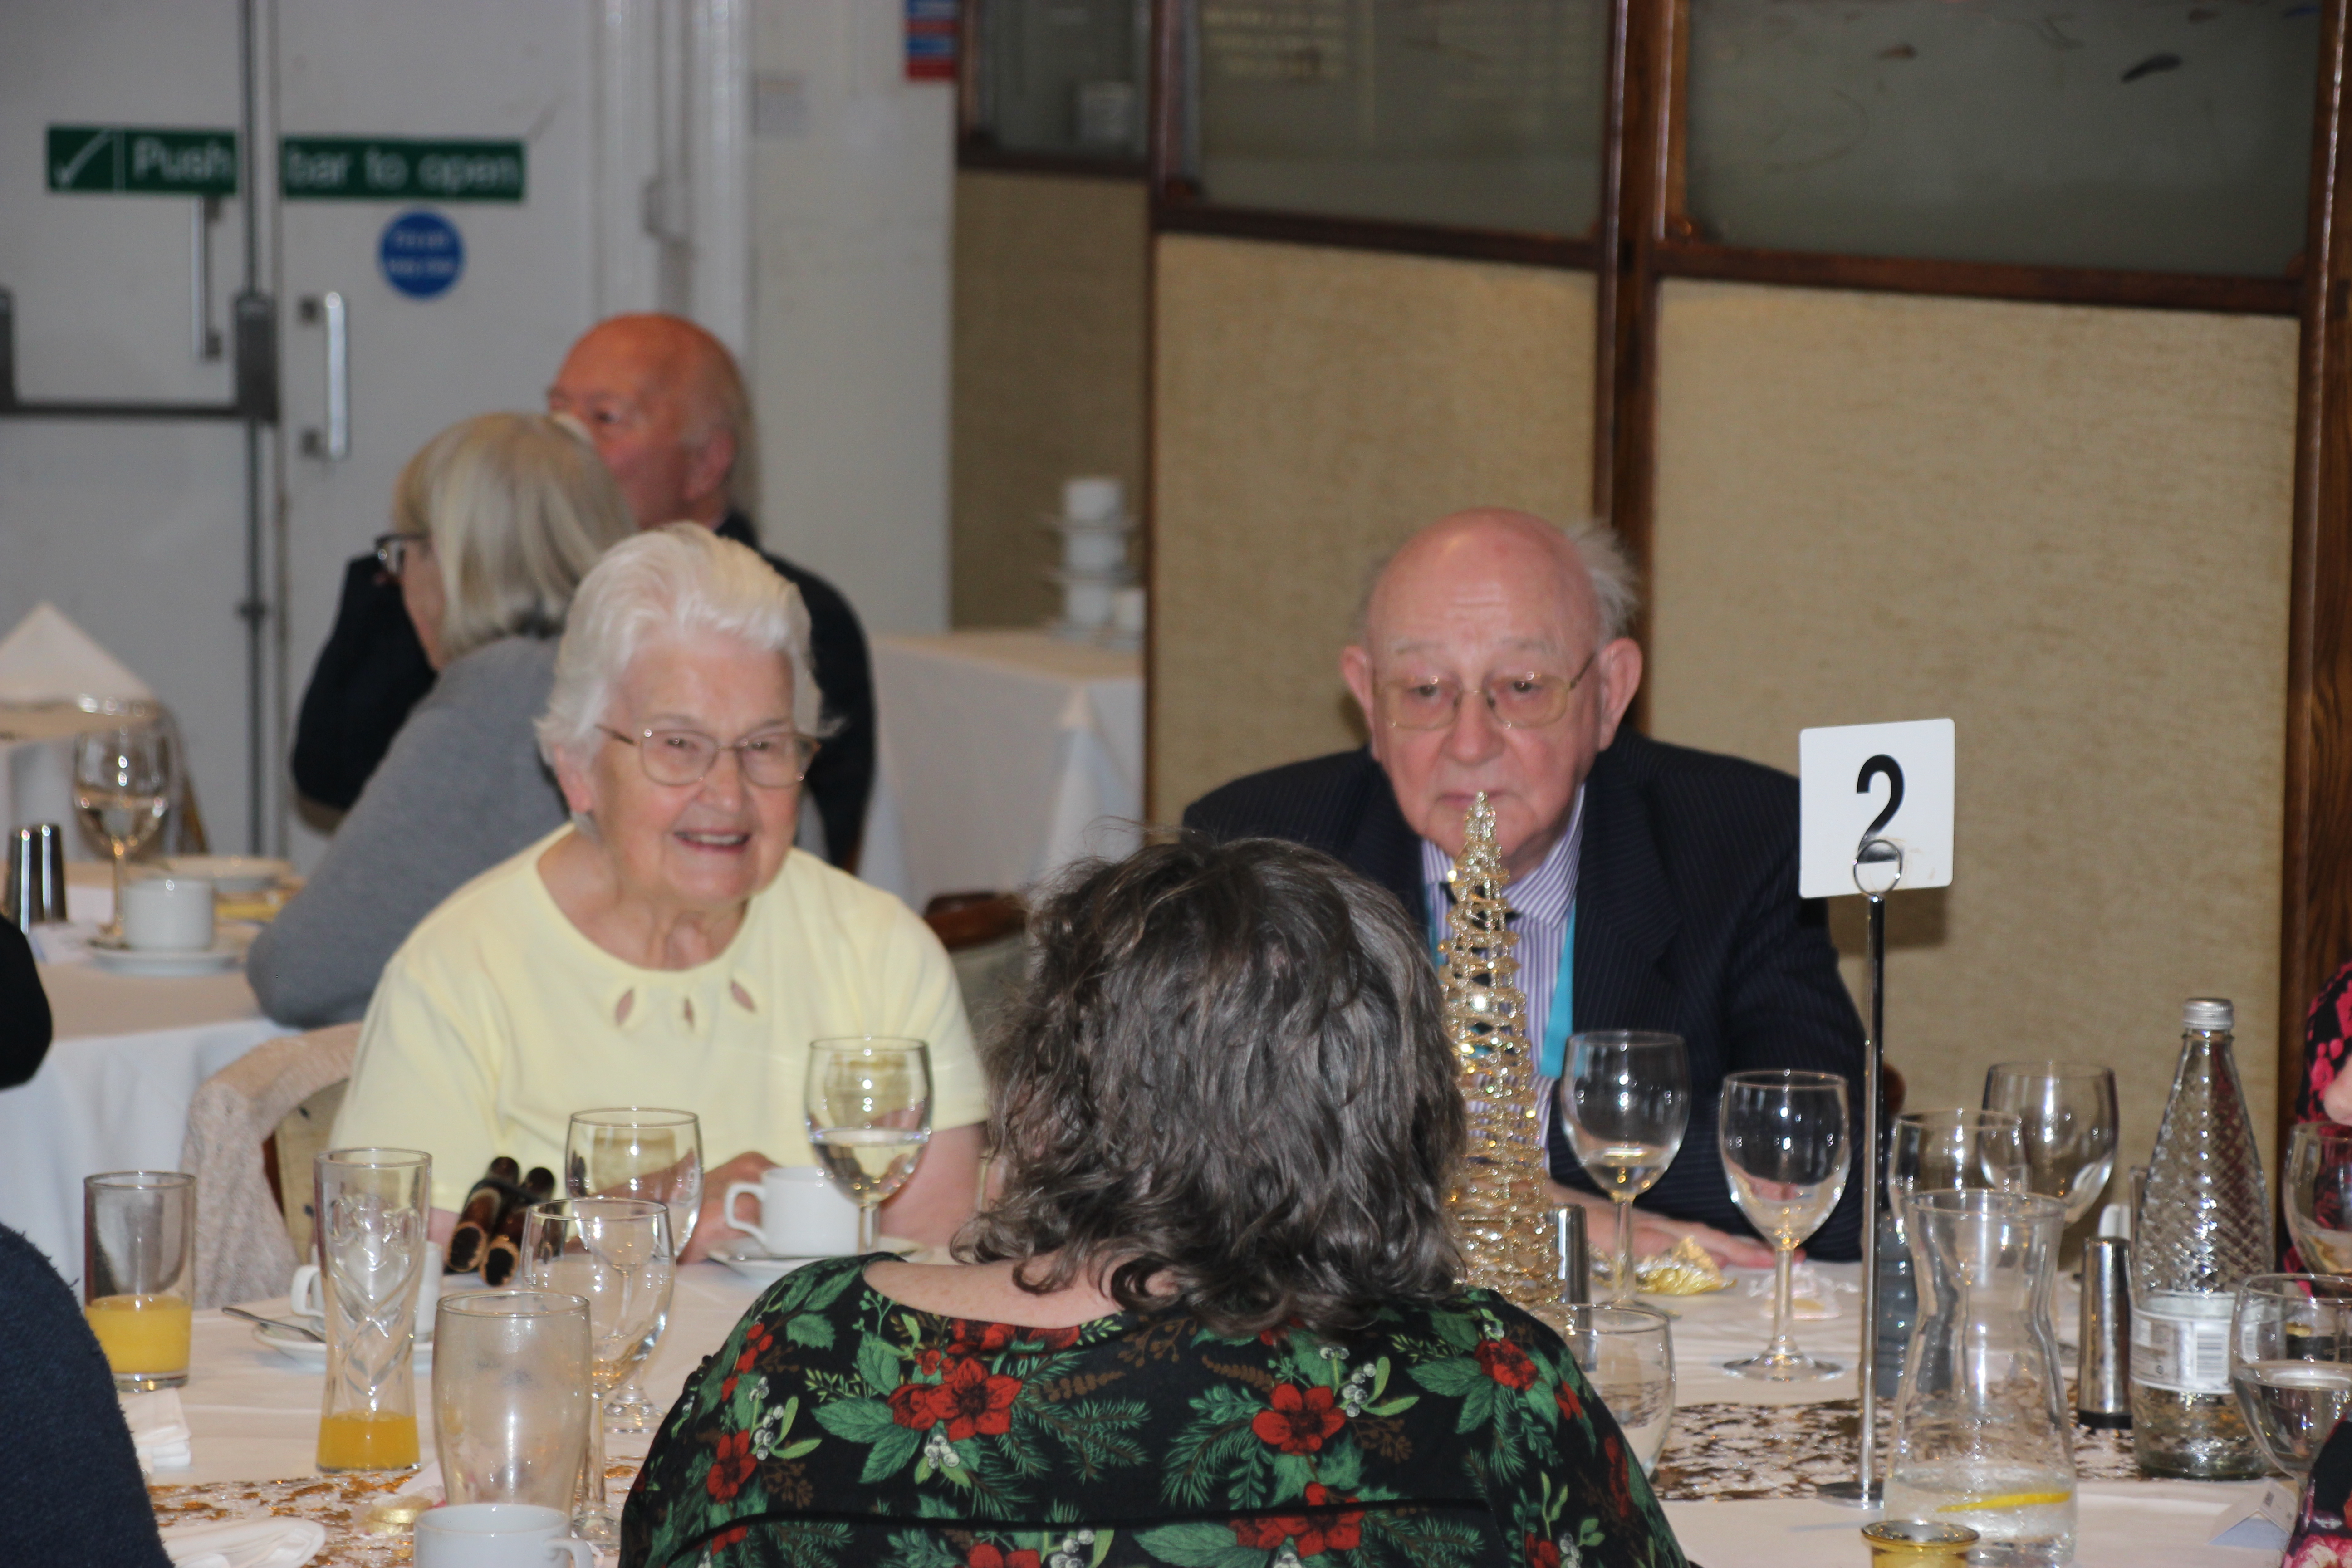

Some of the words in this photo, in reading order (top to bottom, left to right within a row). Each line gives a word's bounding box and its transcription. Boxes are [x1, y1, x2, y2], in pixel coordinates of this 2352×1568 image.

[133, 137, 231, 182] Push
[287, 146, 349, 189] bar
[364, 146, 408, 190] to
[417, 153, 519, 195] open
[1856, 754, 1905, 864] 2
